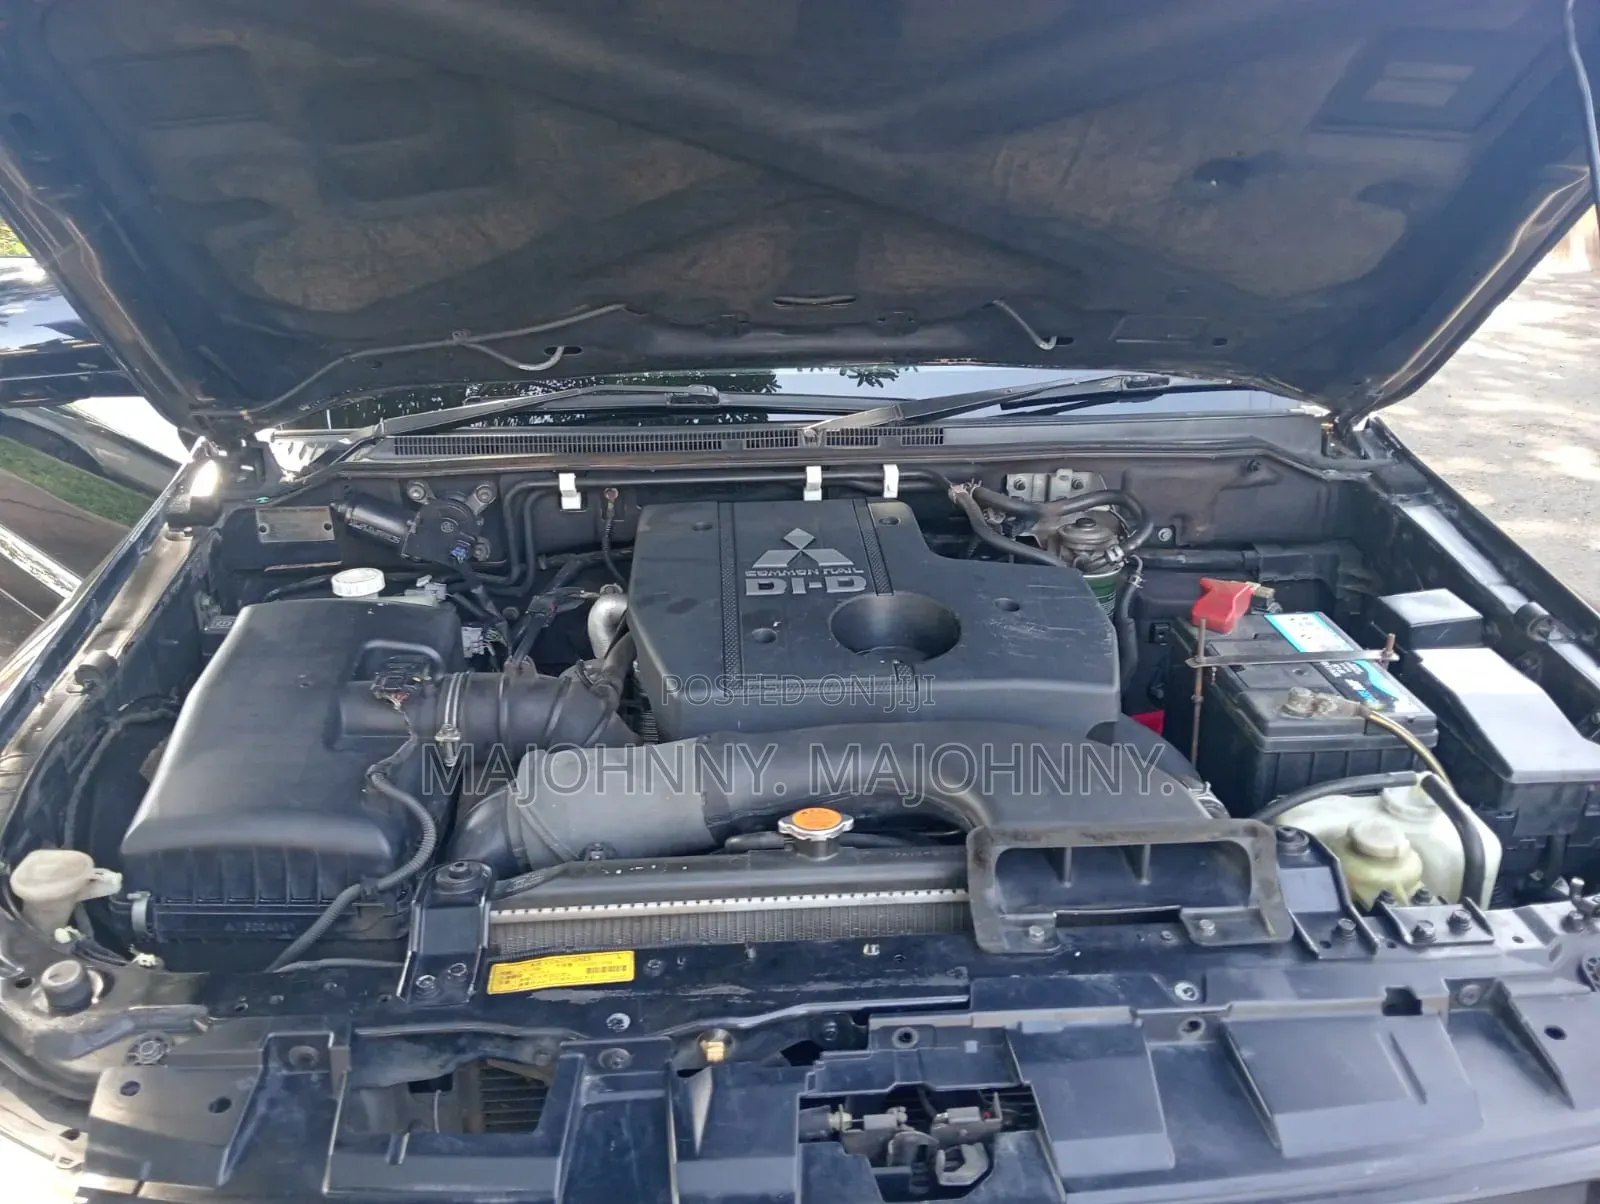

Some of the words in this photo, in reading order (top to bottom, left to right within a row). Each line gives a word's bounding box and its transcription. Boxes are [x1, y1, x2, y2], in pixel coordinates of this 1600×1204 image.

[745, 568, 820, 577] COMMON
[823, 567, 864, 575] RAIL
[745, 575, 867, 596] DI-D
